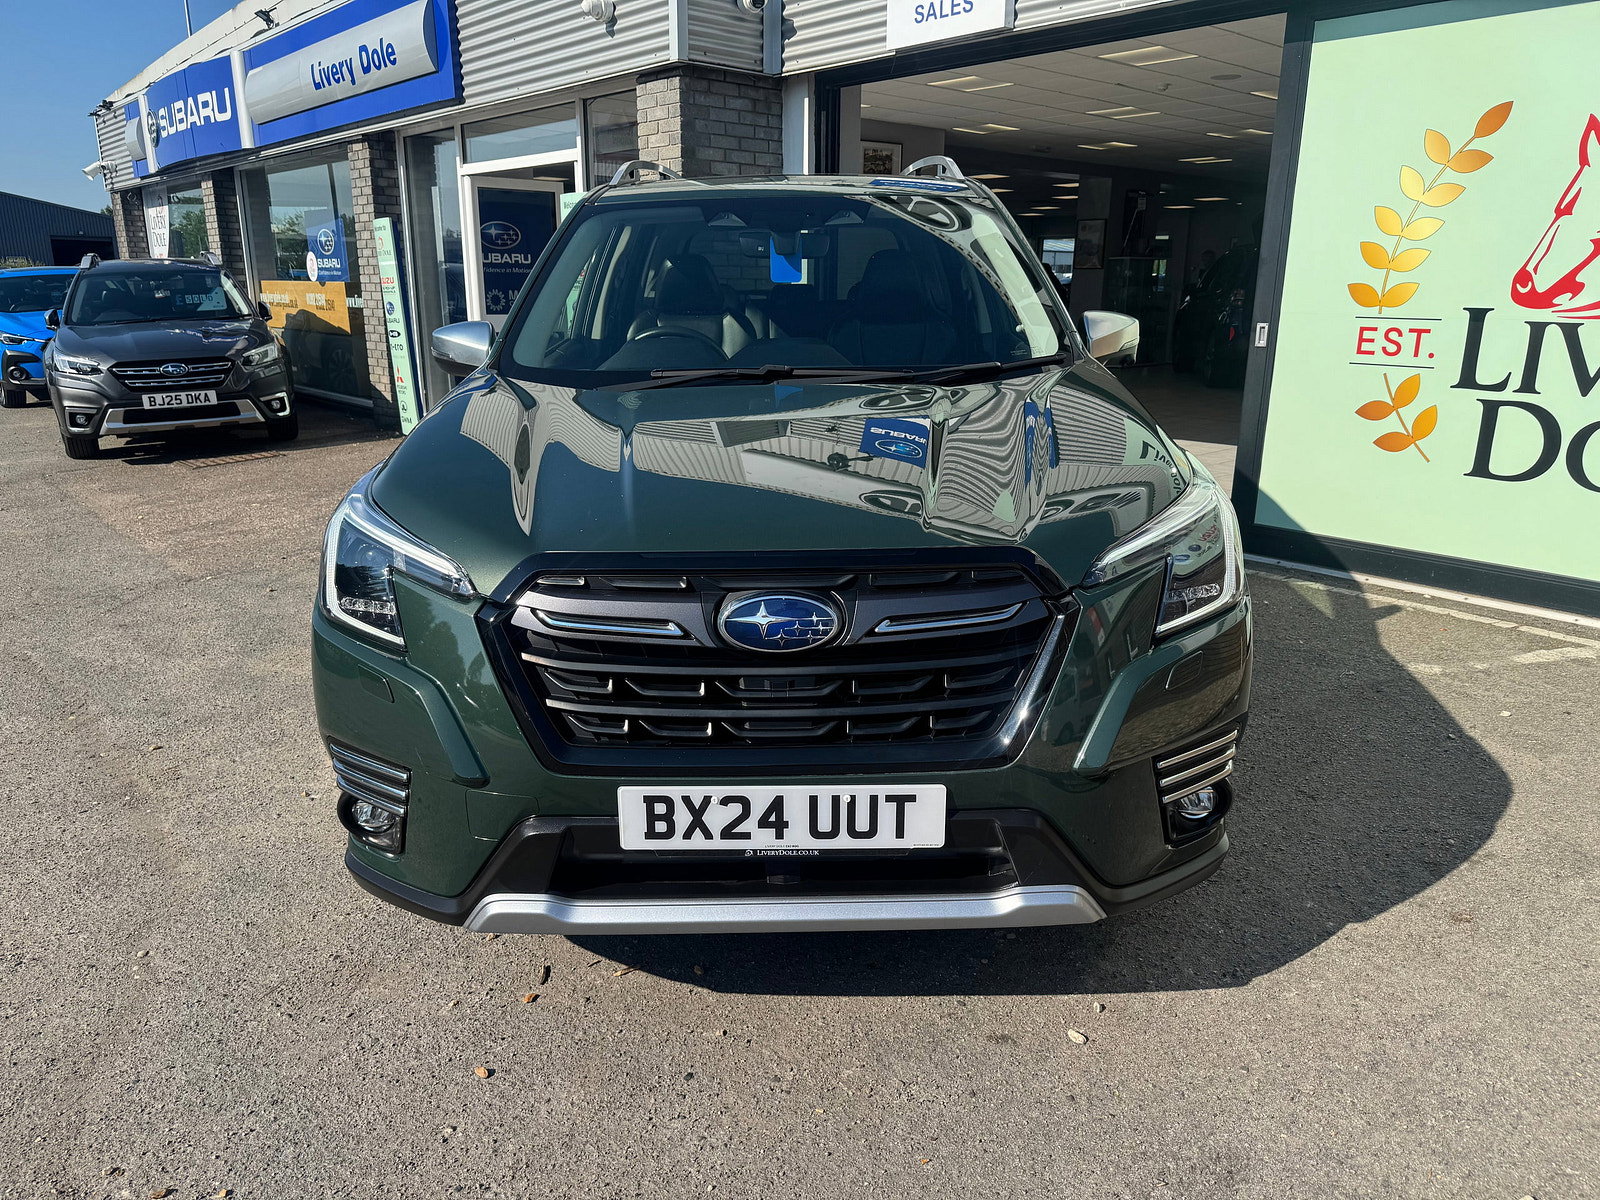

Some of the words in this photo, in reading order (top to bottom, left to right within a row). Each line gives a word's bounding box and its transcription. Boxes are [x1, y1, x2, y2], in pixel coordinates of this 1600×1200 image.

[914, 0, 974, 24] SALES
[310, 56, 357, 91] Livery
[358, 37, 397, 75] Dole
[158, 88, 232, 138] SUBARU
[317, 258, 341, 268] SUBARU
[482, 252, 532, 264] UBARU
[1356, 326, 1434, 359] EST.
[148, 394, 183, 407] BJ25
[186, 392, 211, 404] DKA
[643, 795, 789, 840] BX24
[808, 794, 917, 840] UUT
